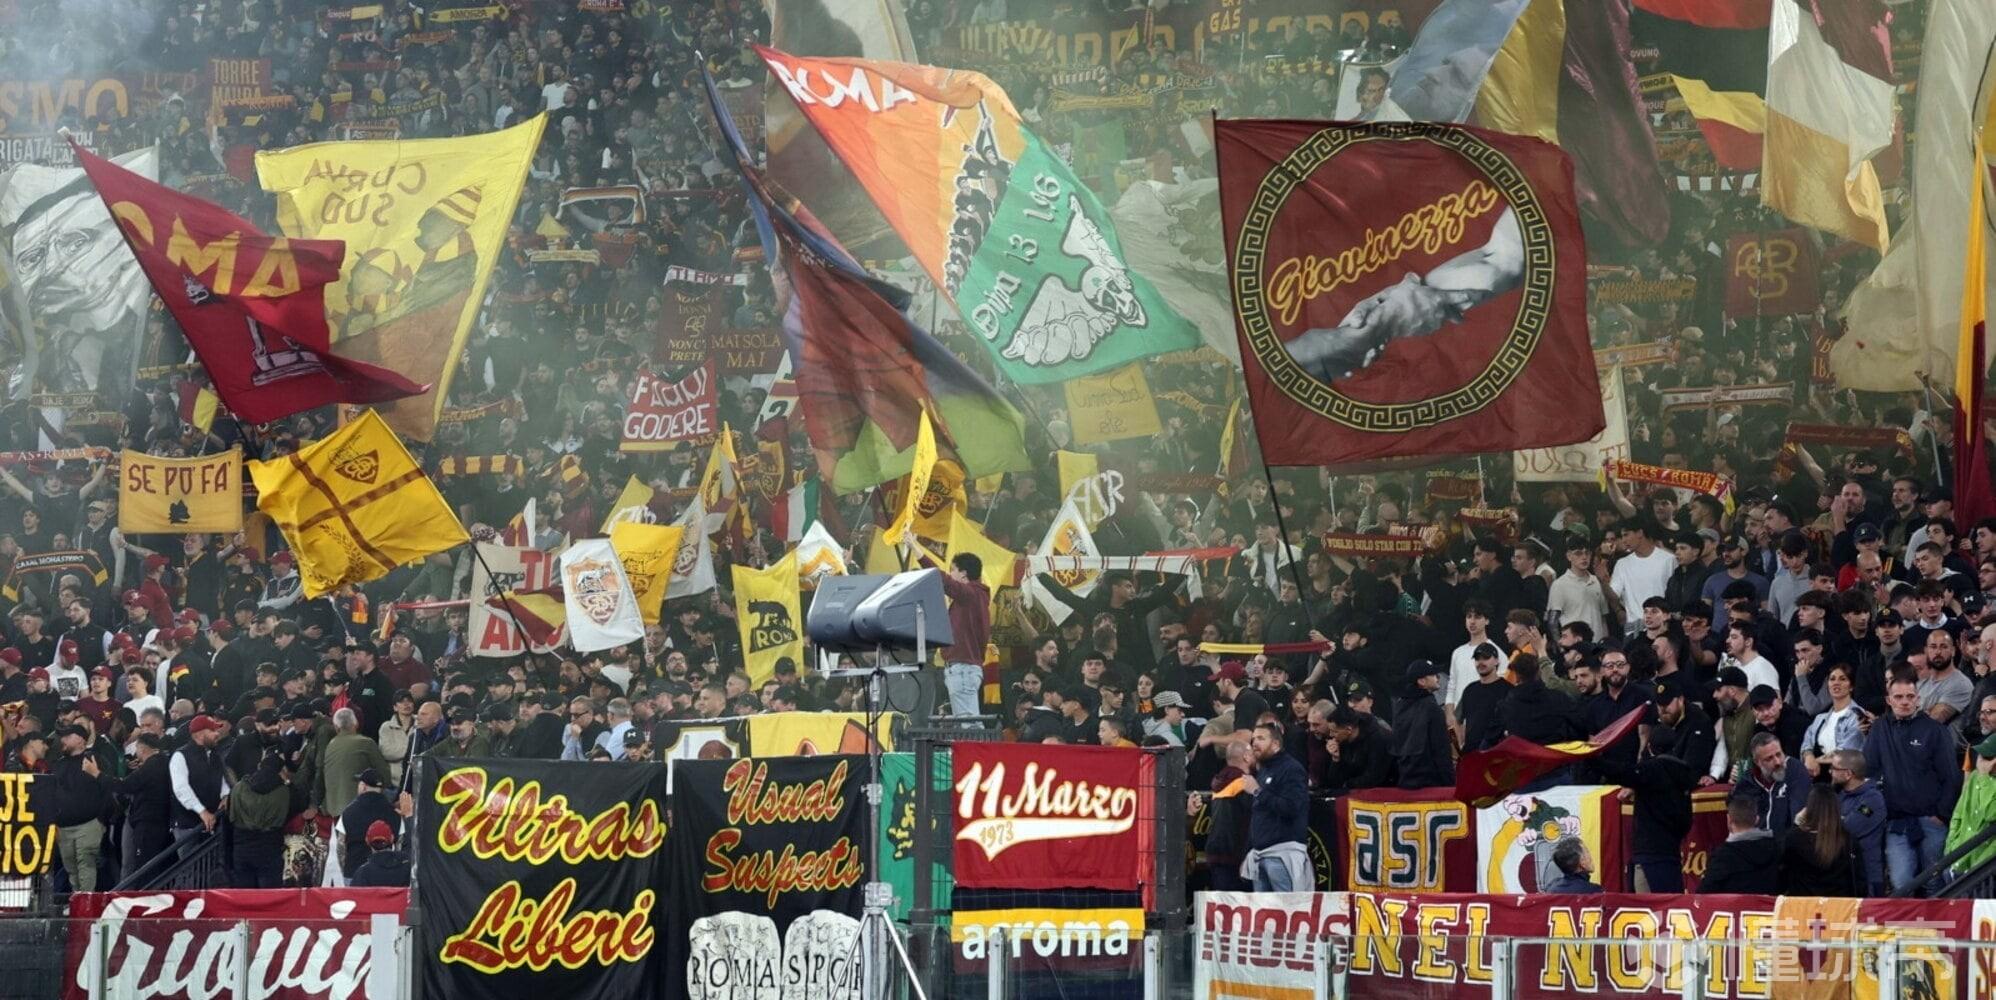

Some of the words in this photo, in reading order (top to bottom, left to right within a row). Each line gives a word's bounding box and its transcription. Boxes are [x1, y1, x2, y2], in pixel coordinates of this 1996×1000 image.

[213, 58, 260, 84] TORRE
[1267, 179, 1498, 325] Giovinezza
[742, 334, 781, 349] SOLA
[727, 351, 766, 369] MAI
[623, 404, 711, 440] GODERE
[128, 463, 156, 494] SE
[201, 461, 231, 494] FA'
[1621, 463, 1658, 479] CUCS
[1670, 471, 1711, 488] ROMA
[1327, 538, 1353, 549] VOGLIO
[1354, 539, 1374, 551] SOLO
[1375, 540, 1394, 551] STAR
[1395, 540, 1412, 551] CON
[724, 757, 848, 826] Usual
[955, 761, 1005, 819] 11
[1001, 761, 1137, 820] Marzo
[435, 766, 667, 865] Ultras
[979, 820, 1014, 848] 1973
[1353, 809, 1461, 889] asr
[702, 828, 865, 909] Suspects
[440, 877, 655, 975] Liberi
[1350, 893, 1493, 984] NEL
[1539, 905, 1776, 999] NOME
[692, 955, 776, 988] ROMA
